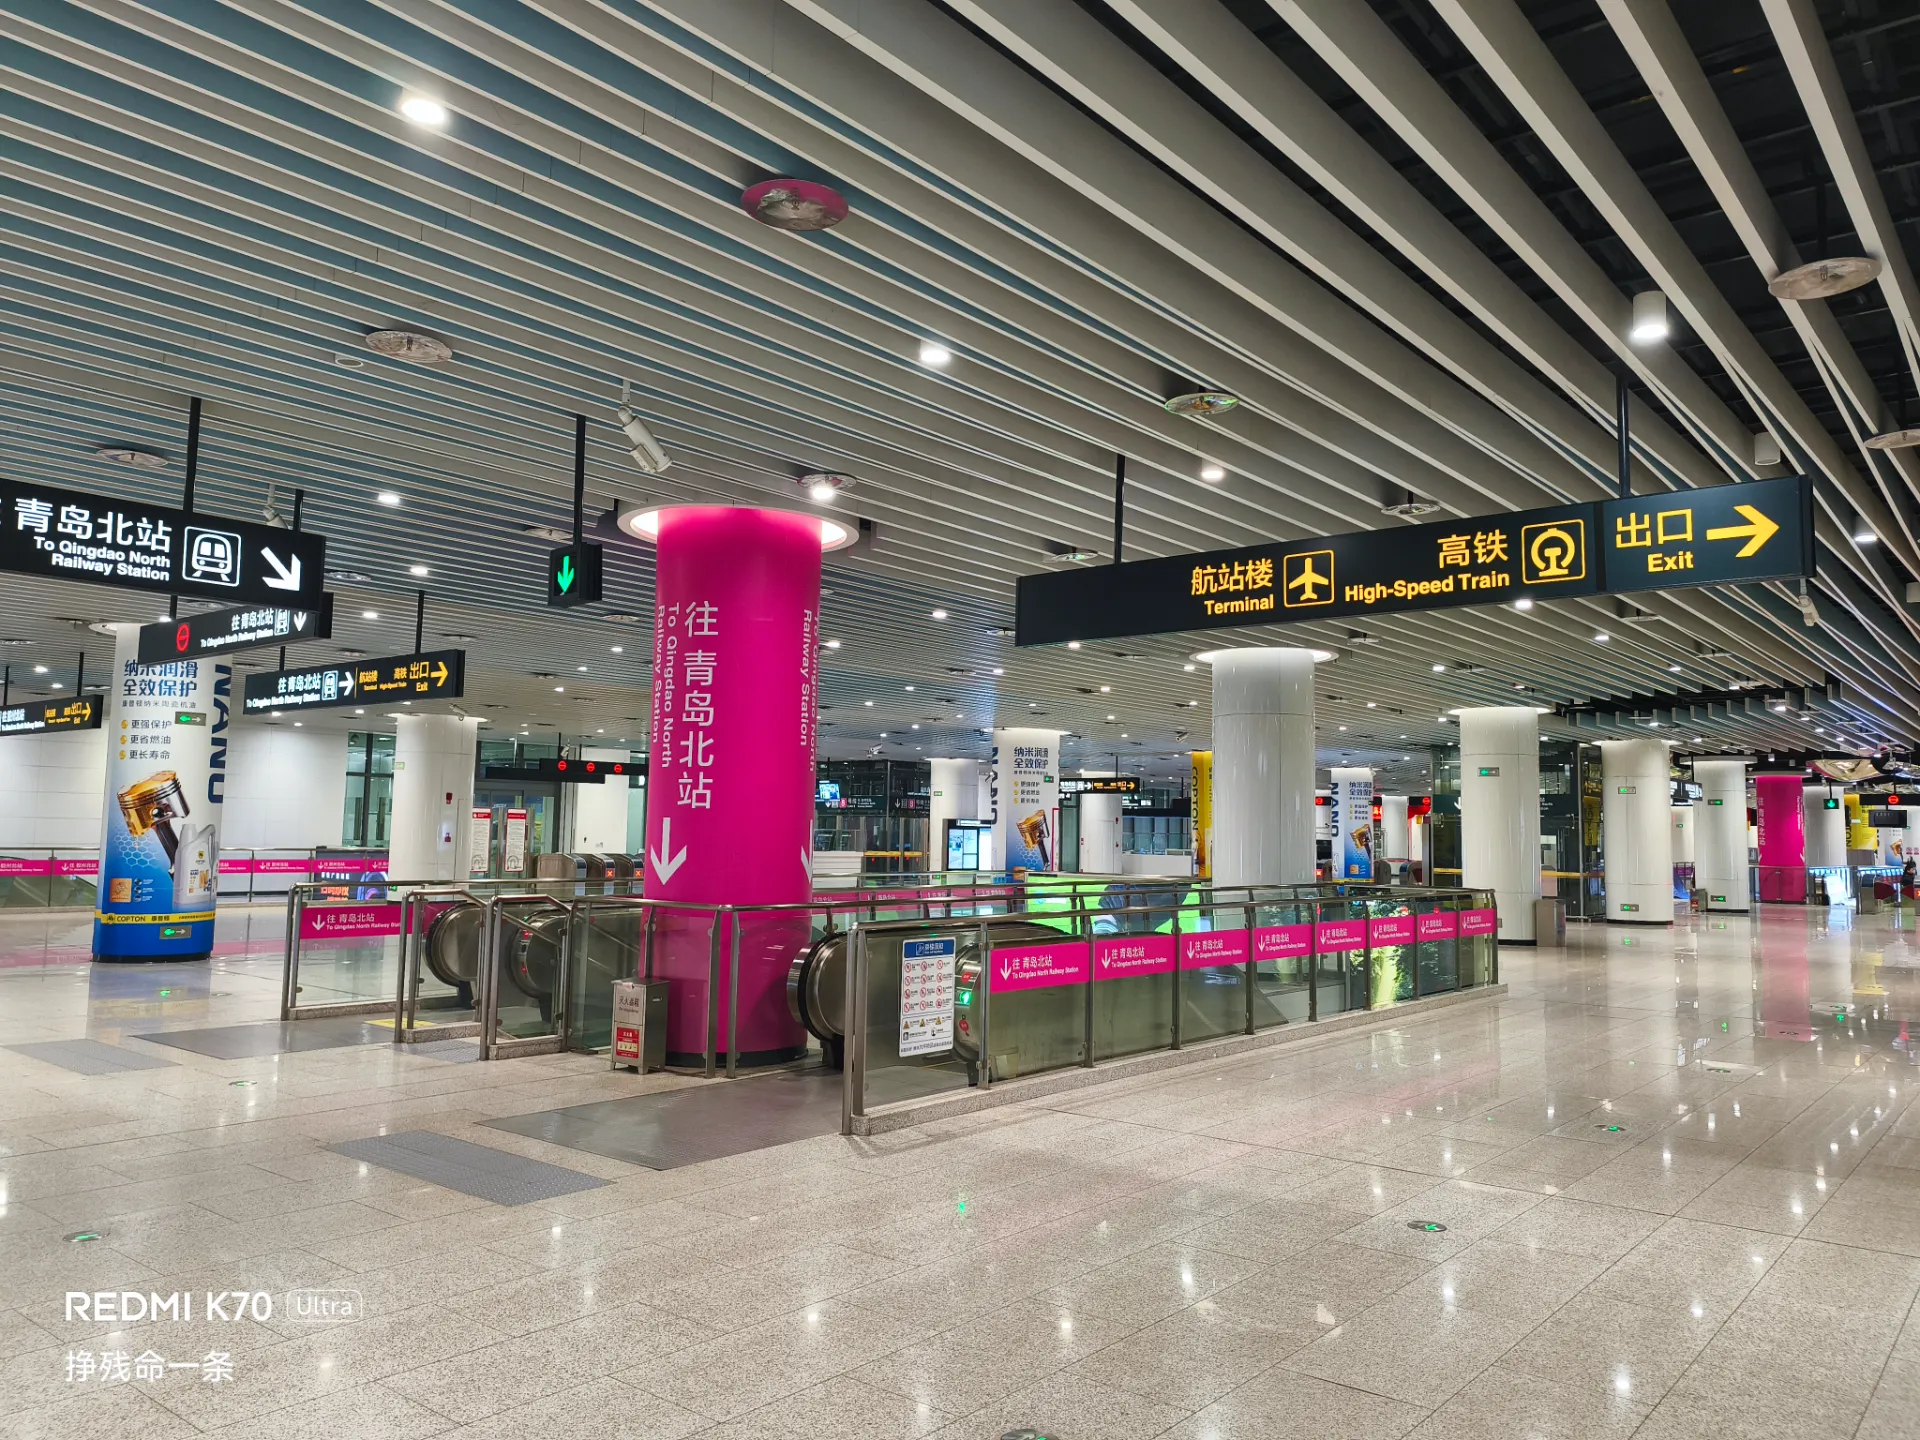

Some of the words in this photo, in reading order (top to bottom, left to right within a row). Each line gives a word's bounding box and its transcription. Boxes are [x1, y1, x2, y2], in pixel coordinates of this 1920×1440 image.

[14, 498, 172, 553] 青岛北站
[1615, 508, 1693, 548] 出口
[34, 536, 55, 551] To
[59, 540, 126, 562] Qingdao
[129, 551, 170, 568] North
[1437, 529, 1509, 569] 高铁
[52, 553, 113, 576] Railway
[117, 562, 170, 581] Station
[1647, 551, 1694, 573] Exit
[1191, 558, 1273, 595] 航站楼
[1344, 575, 1454, 605] High-Speed
[1458, 571, 1510, 590] Train
[667, 602, 680, 628] To
[1204, 594, 1274, 615] Terminal
[231, 614, 240, 631] 往
[241, 608, 274, 630] 青岛北站
[684, 600, 719, 637] 往
[653, 605, 665, 674] Railway
[801, 608, 813, 678] Railway
[124, 659, 198, 678] 纳米润滑
[409, 661, 430, 680] 出口
[663, 635, 678, 712] Qingdao
[123, 679, 197, 697] 全效保护
[277, 677, 287, 694] 往
[288, 672, 321, 692] 青岛北站
[416, 681, 428, 692] Exit
[652, 680, 662, 743] Station
[800, 683, 810, 747] Station
[131, 719, 172, 730] 更强保护
[677, 650, 717, 809] 青岛北站
[130, 735, 171, 745] 更省燃油
[661, 717, 674, 768] North
[1014, 746, 1048, 758] 纳米润滑
[129, 750, 170, 760] 更长寿命
[1014, 758, 1048, 769] 全效保护
[327, 914, 336, 924] 往
[339, 913, 375, 923] 青岛北站
[1012, 957, 1020, 970] 往
[1022, 954, 1052, 970] 青岛北站
[1120, 946, 1144, 959] 青岛北站
